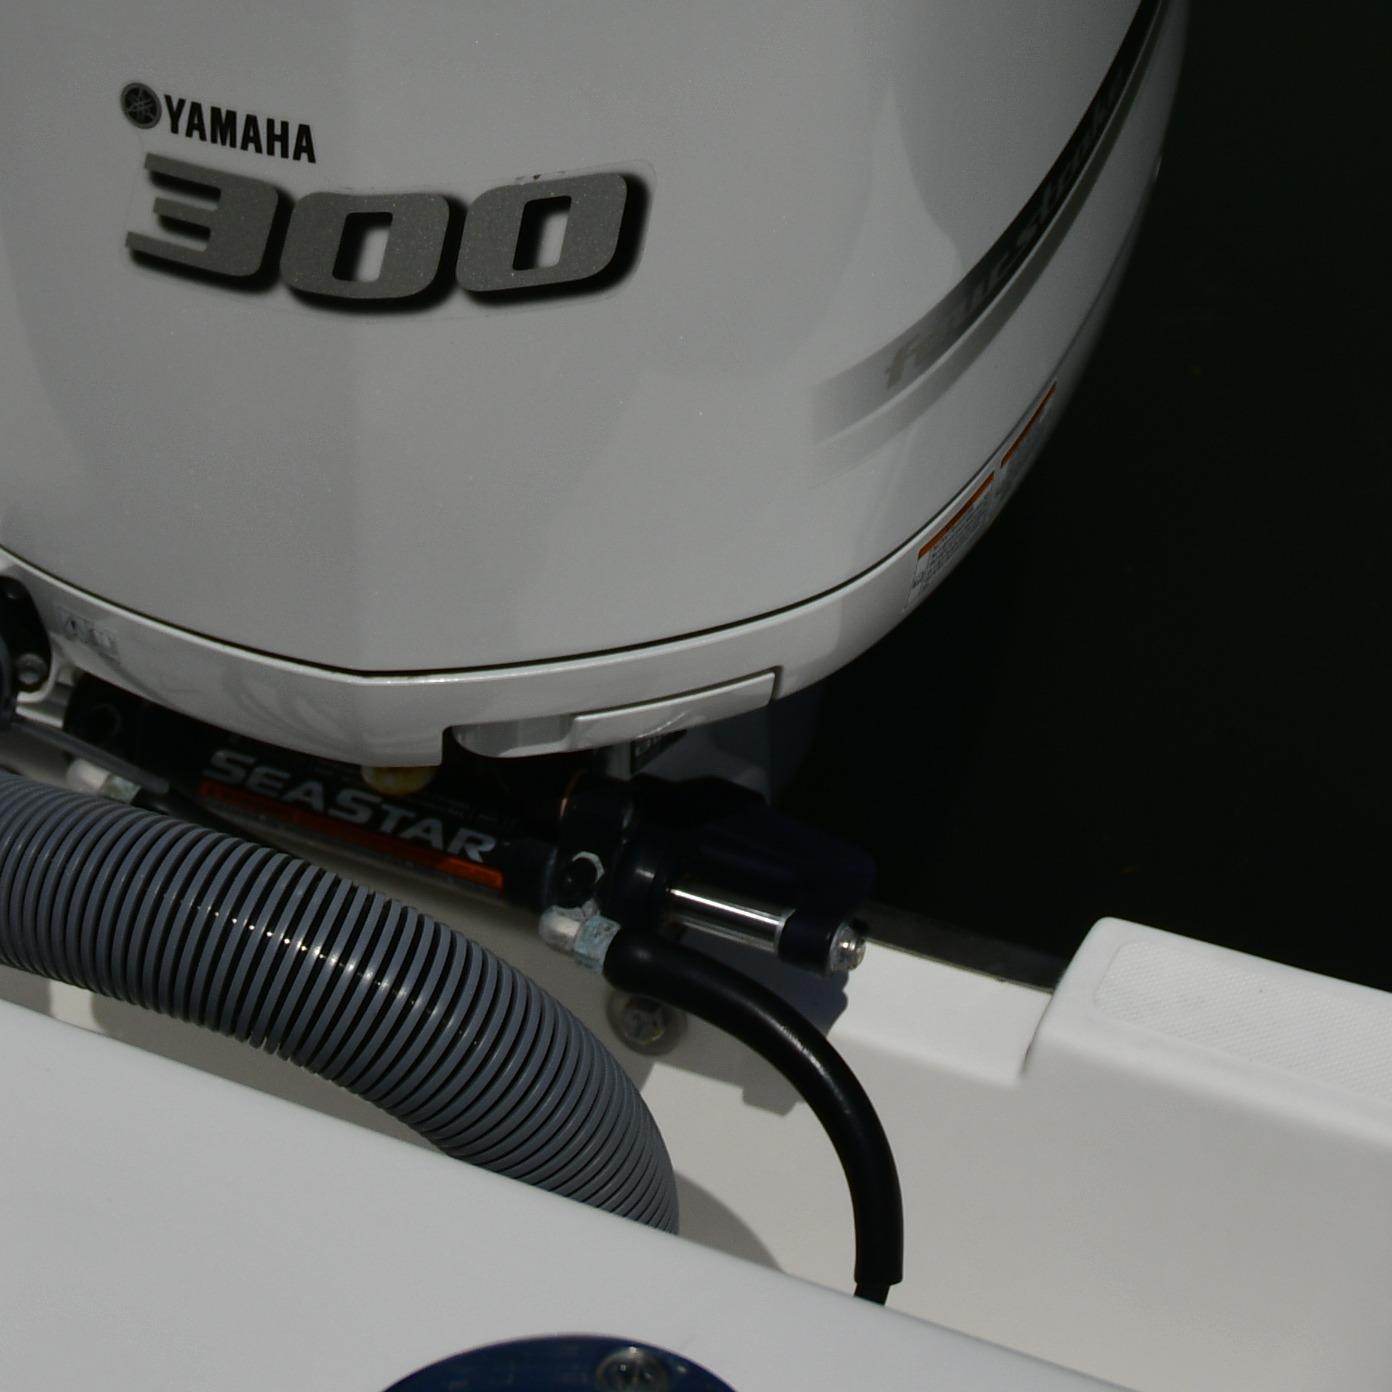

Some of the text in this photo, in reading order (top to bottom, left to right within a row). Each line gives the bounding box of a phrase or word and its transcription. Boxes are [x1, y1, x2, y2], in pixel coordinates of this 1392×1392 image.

[164, 95, 316, 163] YAMAHA
[124, 153, 652, 312] 300
[203, 749, 497, 863] SEASTAR
